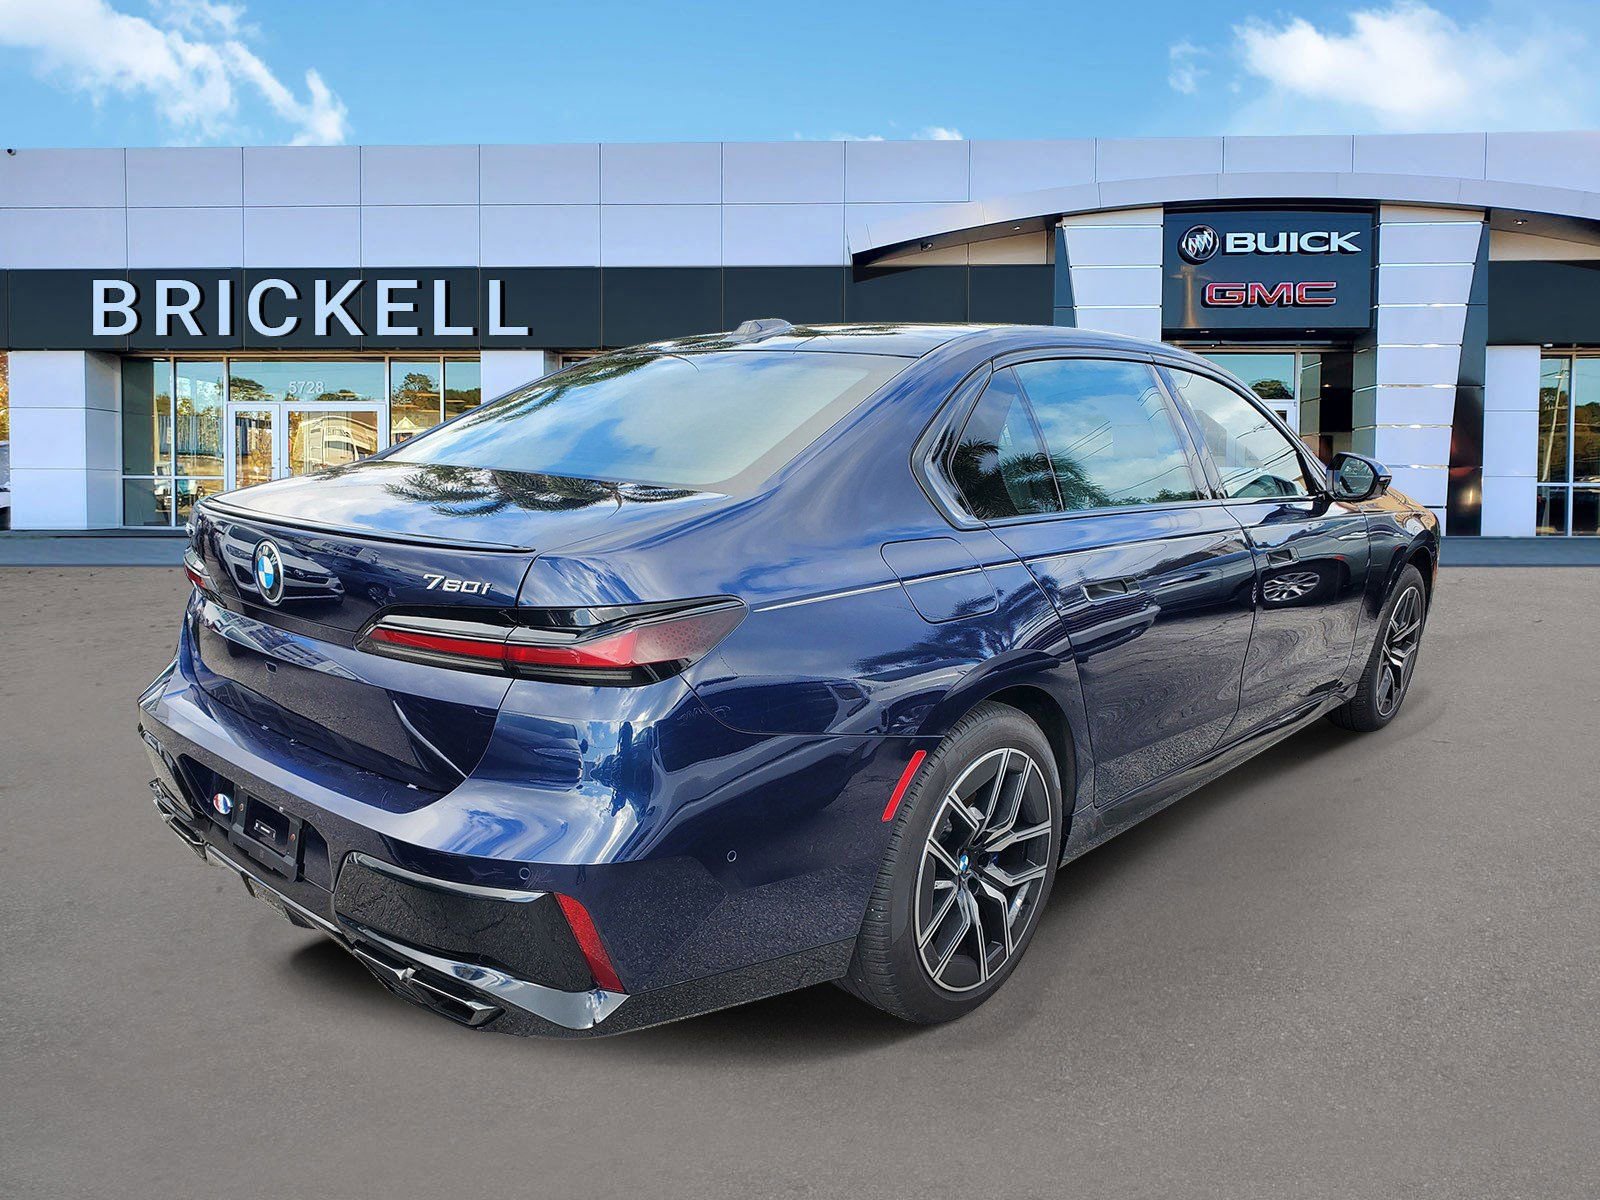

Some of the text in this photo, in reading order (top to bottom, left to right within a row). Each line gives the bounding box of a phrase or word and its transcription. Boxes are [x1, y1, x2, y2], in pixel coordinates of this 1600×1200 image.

[1226, 231, 1361, 253] BUICK
[1205, 281, 1337, 305] GMC
[92, 278, 530, 337] BRICKELL
[288, 381, 324, 394] 5728
[423, 574, 492, 595] 760i
